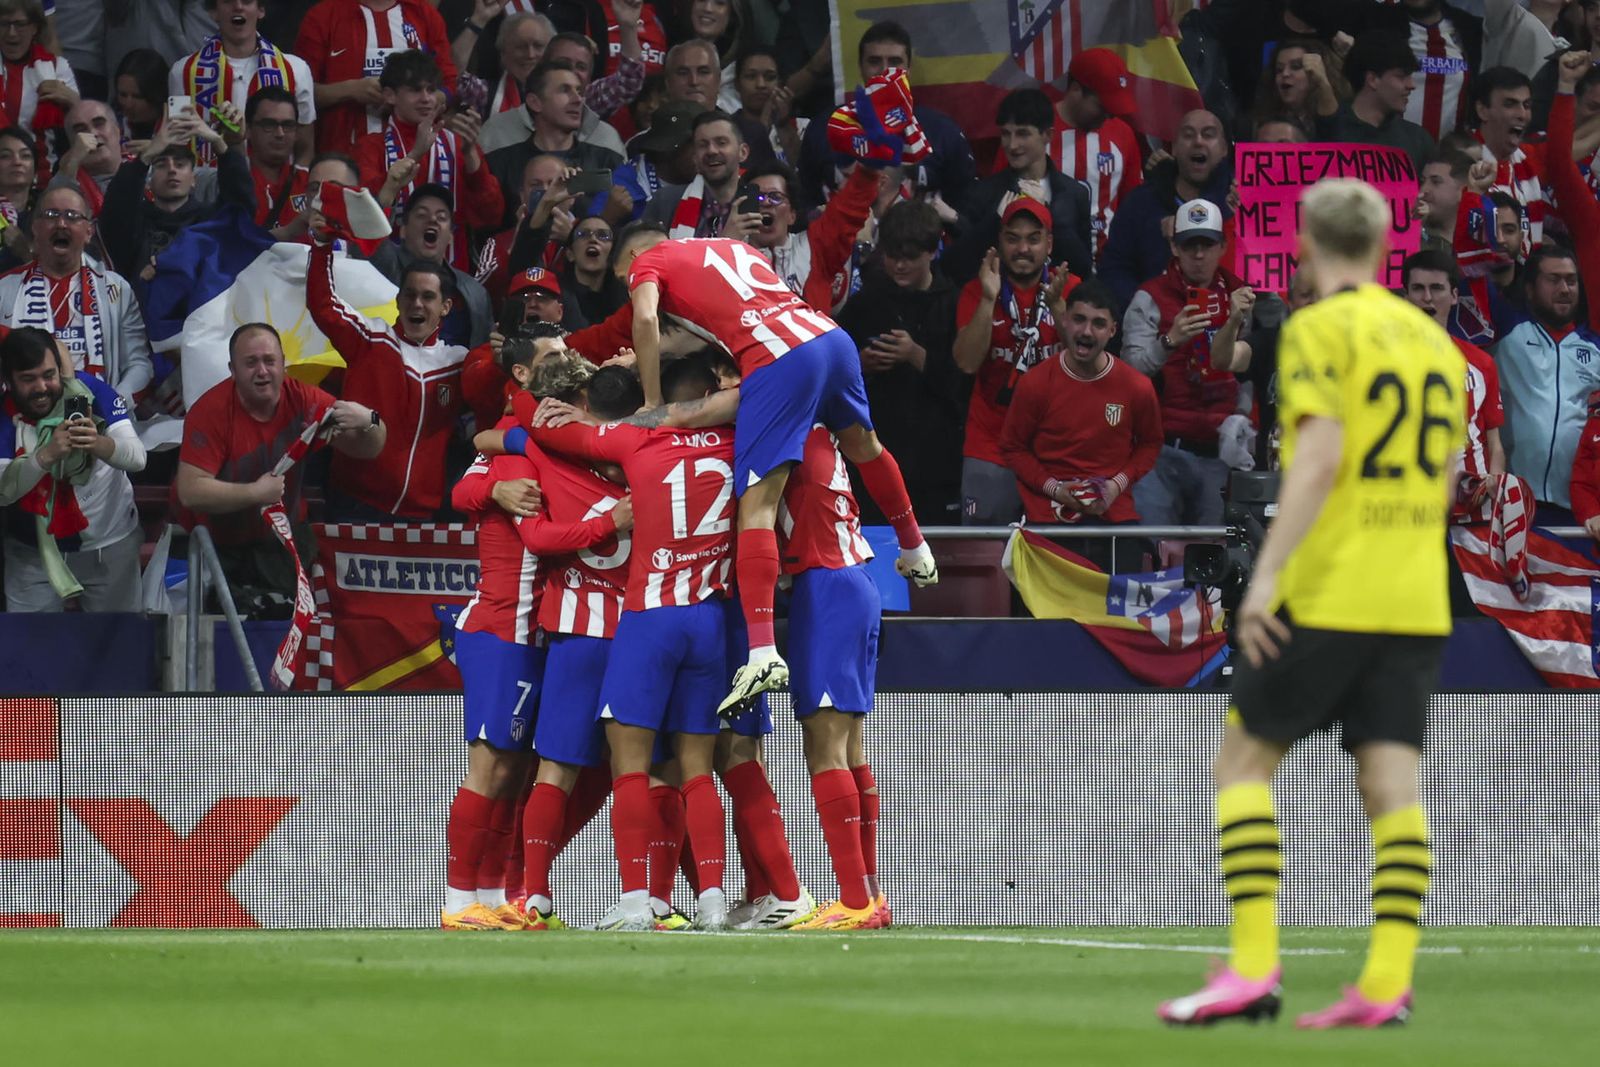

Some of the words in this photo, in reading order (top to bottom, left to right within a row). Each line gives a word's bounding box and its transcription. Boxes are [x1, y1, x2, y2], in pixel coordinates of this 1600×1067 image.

[1241, 151, 1414, 186] GRIEZMANN
[1239, 202, 1282, 237] ME
[703, 244, 791, 301] 16
[1361, 372, 1455, 478] 26
[662, 457, 734, 539] 12
[676, 552, 698, 562] Save
[344, 558, 481, 592] ATLETICO
[513, 680, 532, 716] 7
